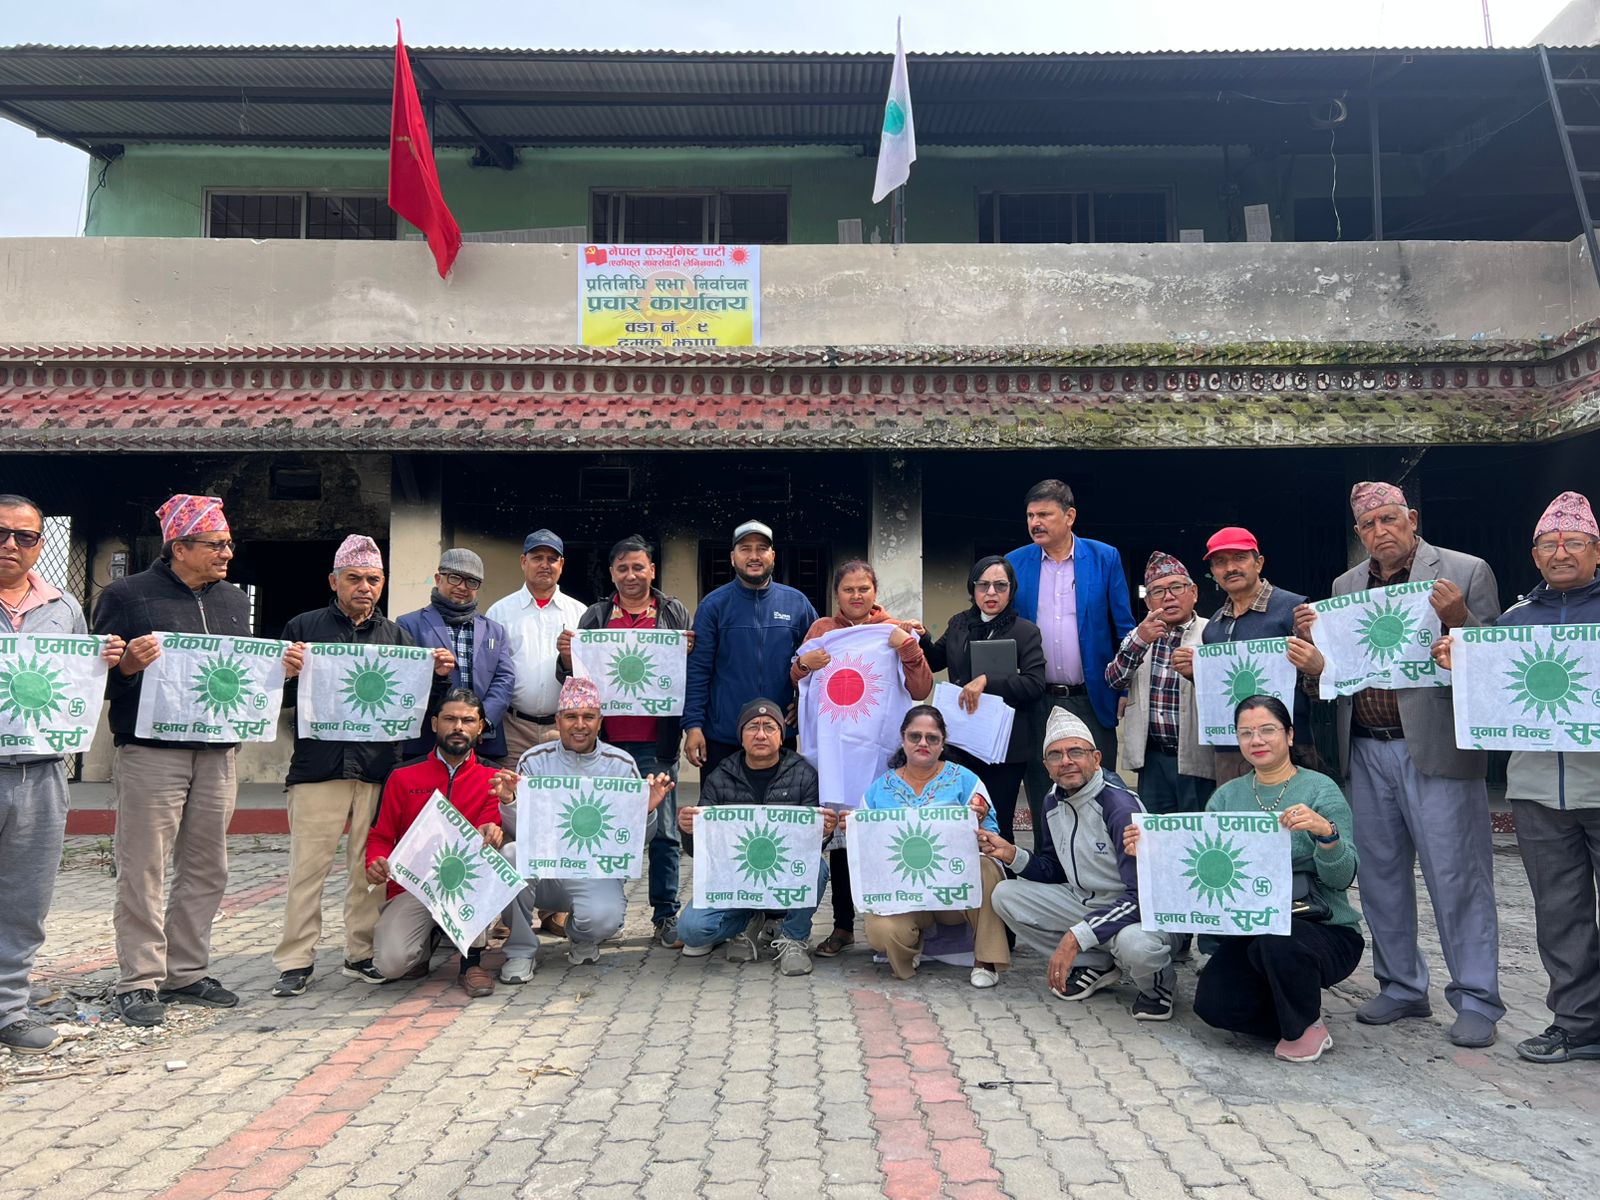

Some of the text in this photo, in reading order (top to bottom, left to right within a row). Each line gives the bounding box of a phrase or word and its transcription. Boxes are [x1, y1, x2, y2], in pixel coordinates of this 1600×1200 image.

[608, 245, 640, 256] नेपाल
[645, 245, 698, 258] कम्युनिष्ट
[586, 274, 749, 292] प्रतिनिधि सभा निर्वाचन
[587, 293, 748, 313] प्रचार कार्यालय
[625, 322, 655, 333] वडा
[698, 322, 708, 333] ९
[163, 632, 222, 652] नेकपा
[152, 721, 188, 733] चुनाव
[192, 721, 223, 735] चिन्ह
[310, 721, 339, 732] चुनाव
[342, 720, 372, 733] चिन्ह
[1205, 725, 1226, 737] चुनाव
[1470, 726, 1508, 739] चुनाव
[1512, 724, 1552, 740] चिन्ह
[703, 806, 755, 821] नेकपा
[528, 859, 557, 870] चुनाव
[560, 857, 587, 870] चिन्ह
[395, 862, 421, 885] चुनाव
[705, 891, 734, 903] चुनाव
[737, 889, 763, 902] चिन्ह
[862, 893, 892, 905] चुनाव
[895, 890, 923, 903] चिन्ह
[1154, 912, 1187, 925] चुनाव
[1190, 911, 1221, 926] चिन्ह
